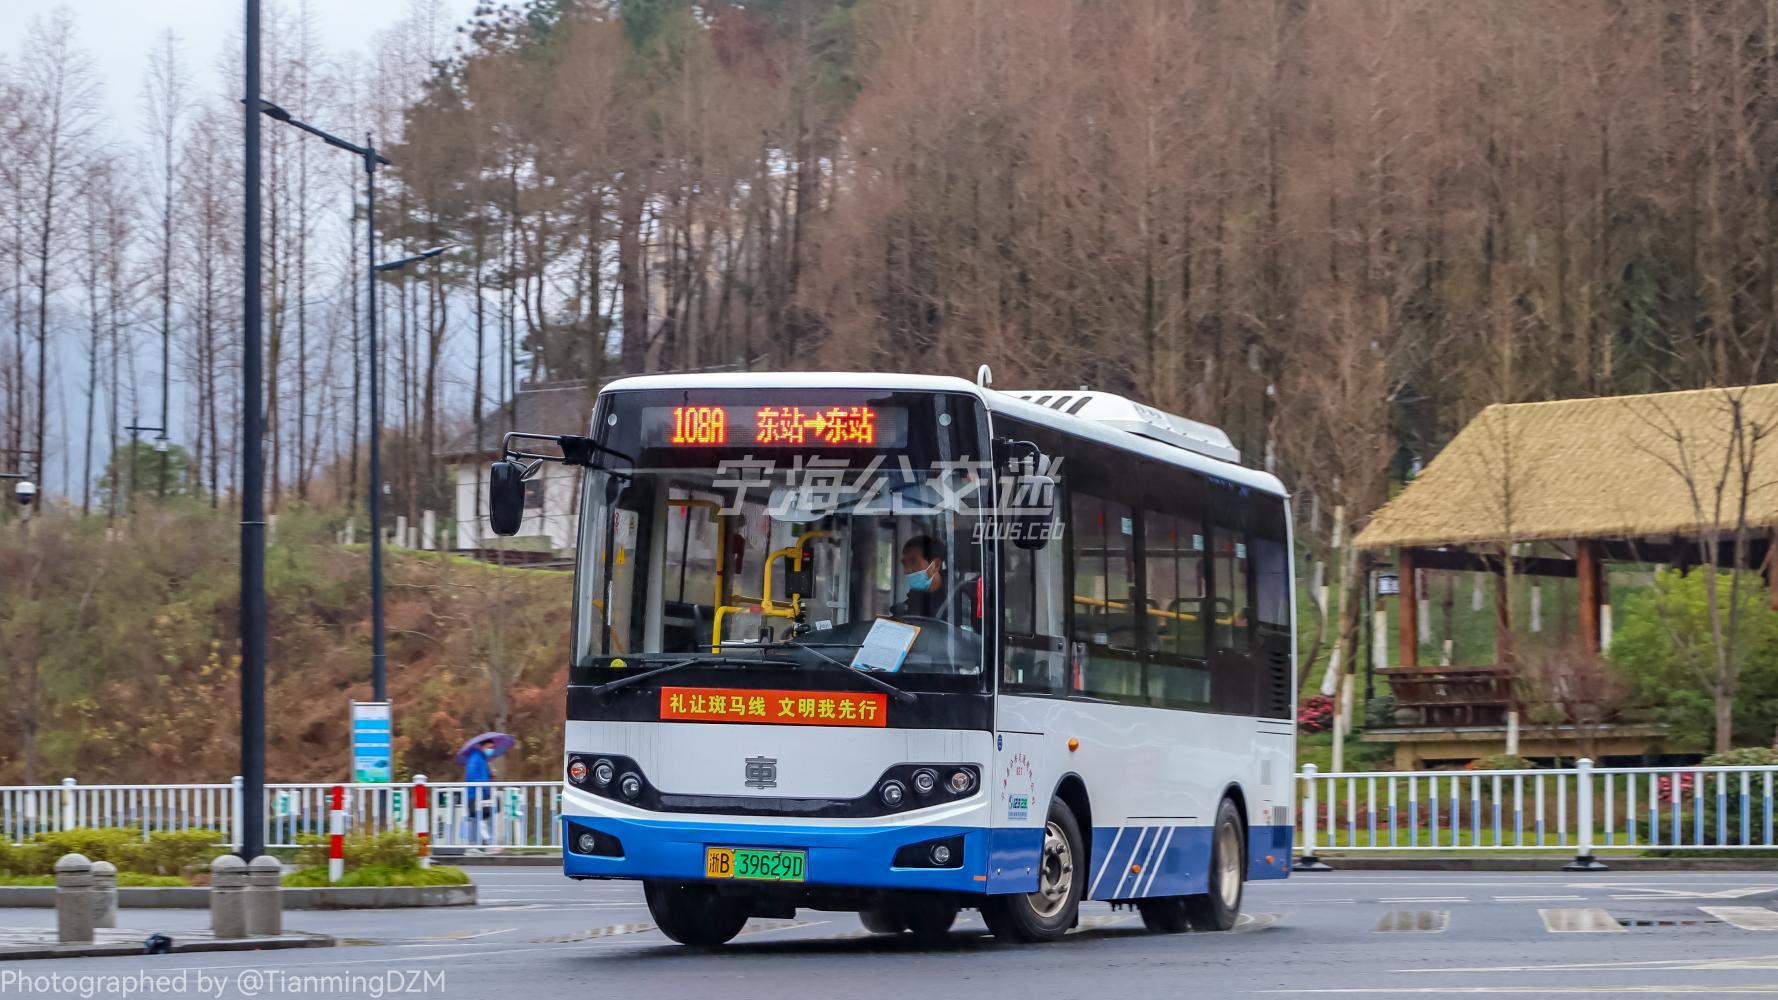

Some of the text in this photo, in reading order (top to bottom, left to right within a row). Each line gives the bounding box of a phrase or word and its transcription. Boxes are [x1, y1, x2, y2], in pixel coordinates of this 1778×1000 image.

[671, 407, 726, 444] 108A
[756, 406, 876, 444] 东站 东站
[669, 693, 878, 720] 礼让斑马线 文明我先行
[738, 854, 803, 878] 39629D
